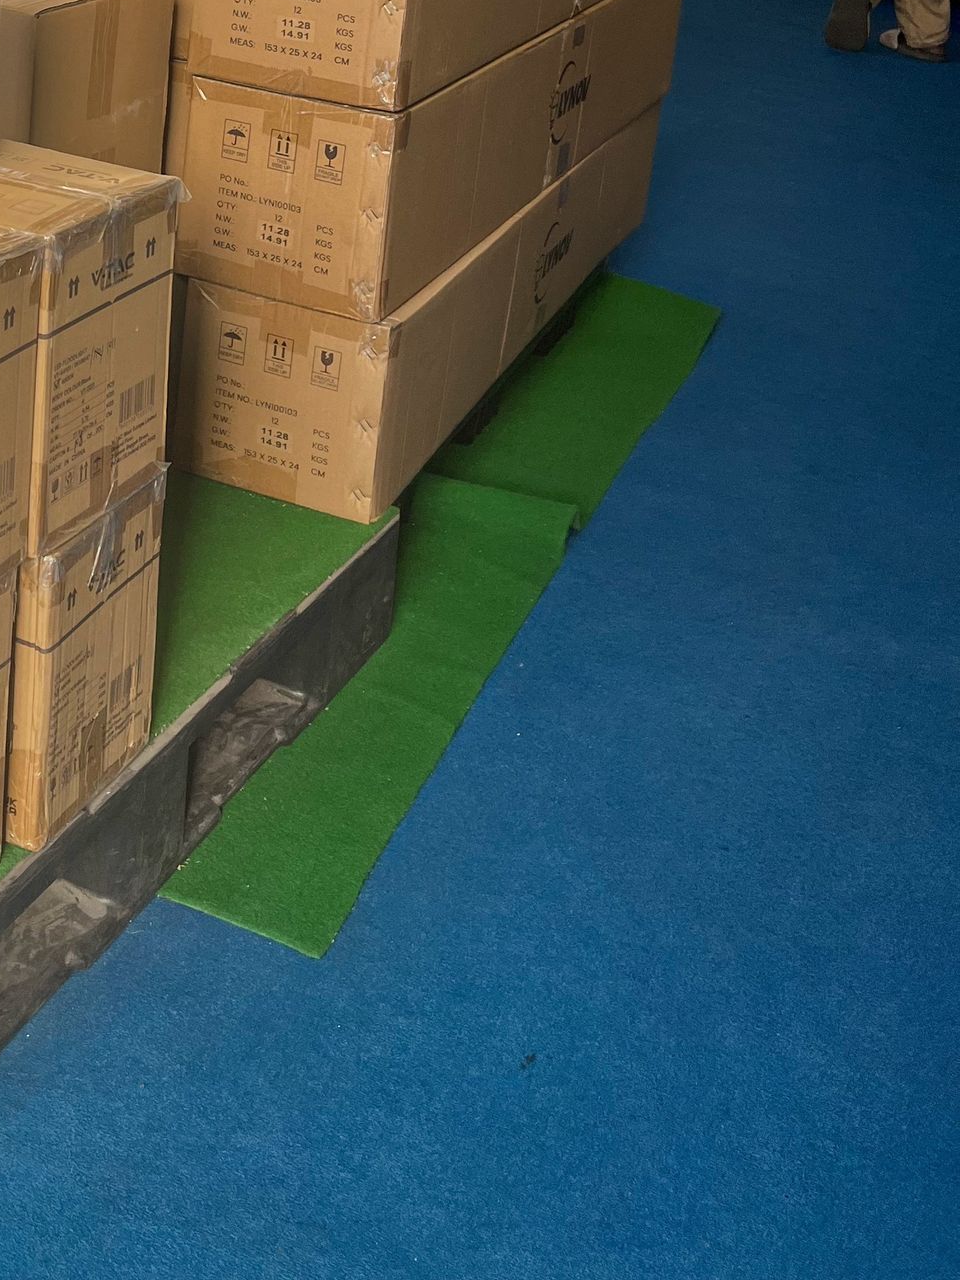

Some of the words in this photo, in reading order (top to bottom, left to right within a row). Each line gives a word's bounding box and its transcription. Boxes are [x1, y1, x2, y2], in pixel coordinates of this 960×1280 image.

[281, 19, 311, 30] 11.28
[335, 27, 355, 38] KGS
[337, 13, 356, 24] PCS
[280, 29, 309, 41] 14.91
[334, 42, 353, 52] KGS
[264, 43, 278, 53] 153
[280, 45, 287, 54] X
[289, 47, 300, 57] 25
[302, 50, 309, 59] X
[311, 51, 323, 61] 24
[334, 56, 350, 66] CM
[219, 173, 232, 183] PO
[218, 186, 238, 198] ITEM
[258, 196, 302, 214] LYN100103
[261, 223, 290, 238] 11.28
[314, 238, 333, 250] KGS
[316, 224, 334, 236] PCS
[260, 233, 288, 247] 14.91
[313, 252, 332, 263] KGS
[246, 247, 260, 259] 153
[261, 251, 268, 260] X
[269, 253, 281, 264] 25
[283, 257, 289, 265] X
[291, 259, 303, 270] 24
[313, 265, 329, 277] CM
[216, 374, 229, 385] PO
[215, 387, 235, 399] ITEM
[255, 399, 298, 417] LYN100103
[261, 427, 289, 441] 11.28
[311, 441, 329, 453] KGS
[312, 428, 331, 440] PCS
[260, 436, 288, 450] 14.91
[310, 455, 328, 466] KGS
[243, 448, 257, 459] 153
[259, 453, 266, 461] X
[267, 455, 278, 466] 25
[280, 459, 287, 467] X
[288, 461, 300, 471] 24
[310, 468, 326, 479] CM
